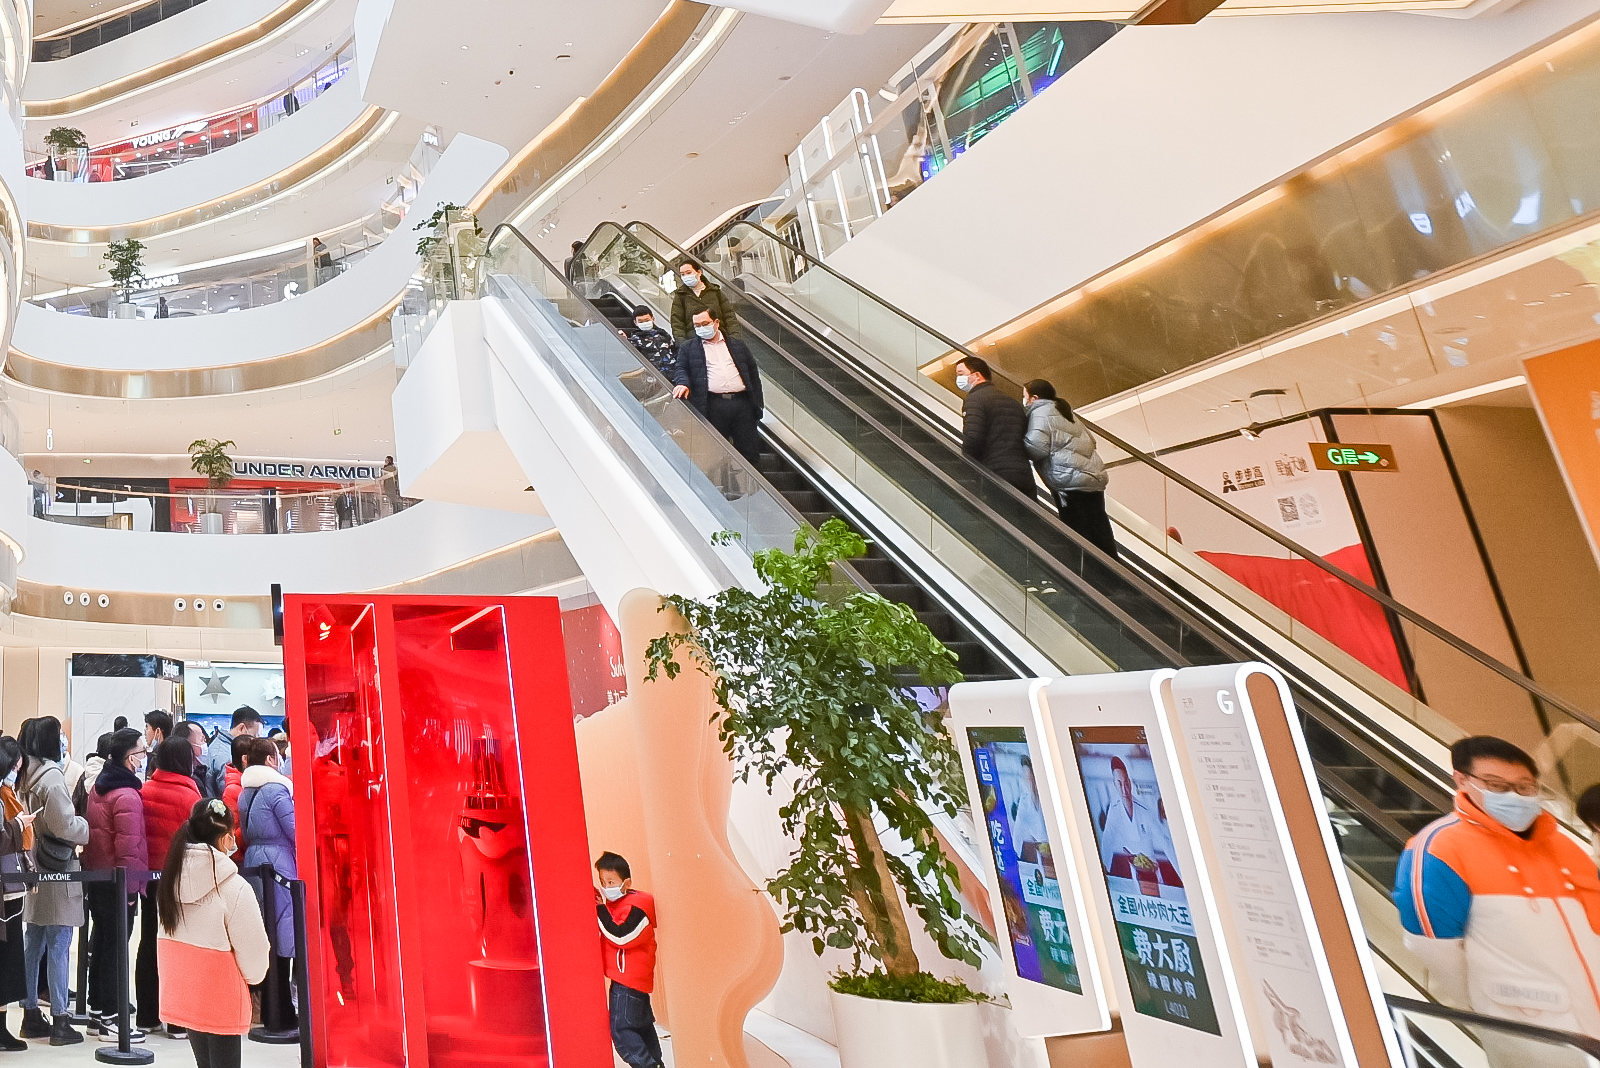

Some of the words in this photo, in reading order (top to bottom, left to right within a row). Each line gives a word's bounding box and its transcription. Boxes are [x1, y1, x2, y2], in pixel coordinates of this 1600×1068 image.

[1326, 448, 1360, 466] G层
[234, 462, 305, 478] UNDER
[308, 465, 383, 480] ARMOU
[1216, 689, 1235, 716] G
[38, 872, 72, 882] LANCÔME
[1117, 894, 1192, 927] 全国小炒肉大王
[1131, 928, 1196, 978] 费大厨
